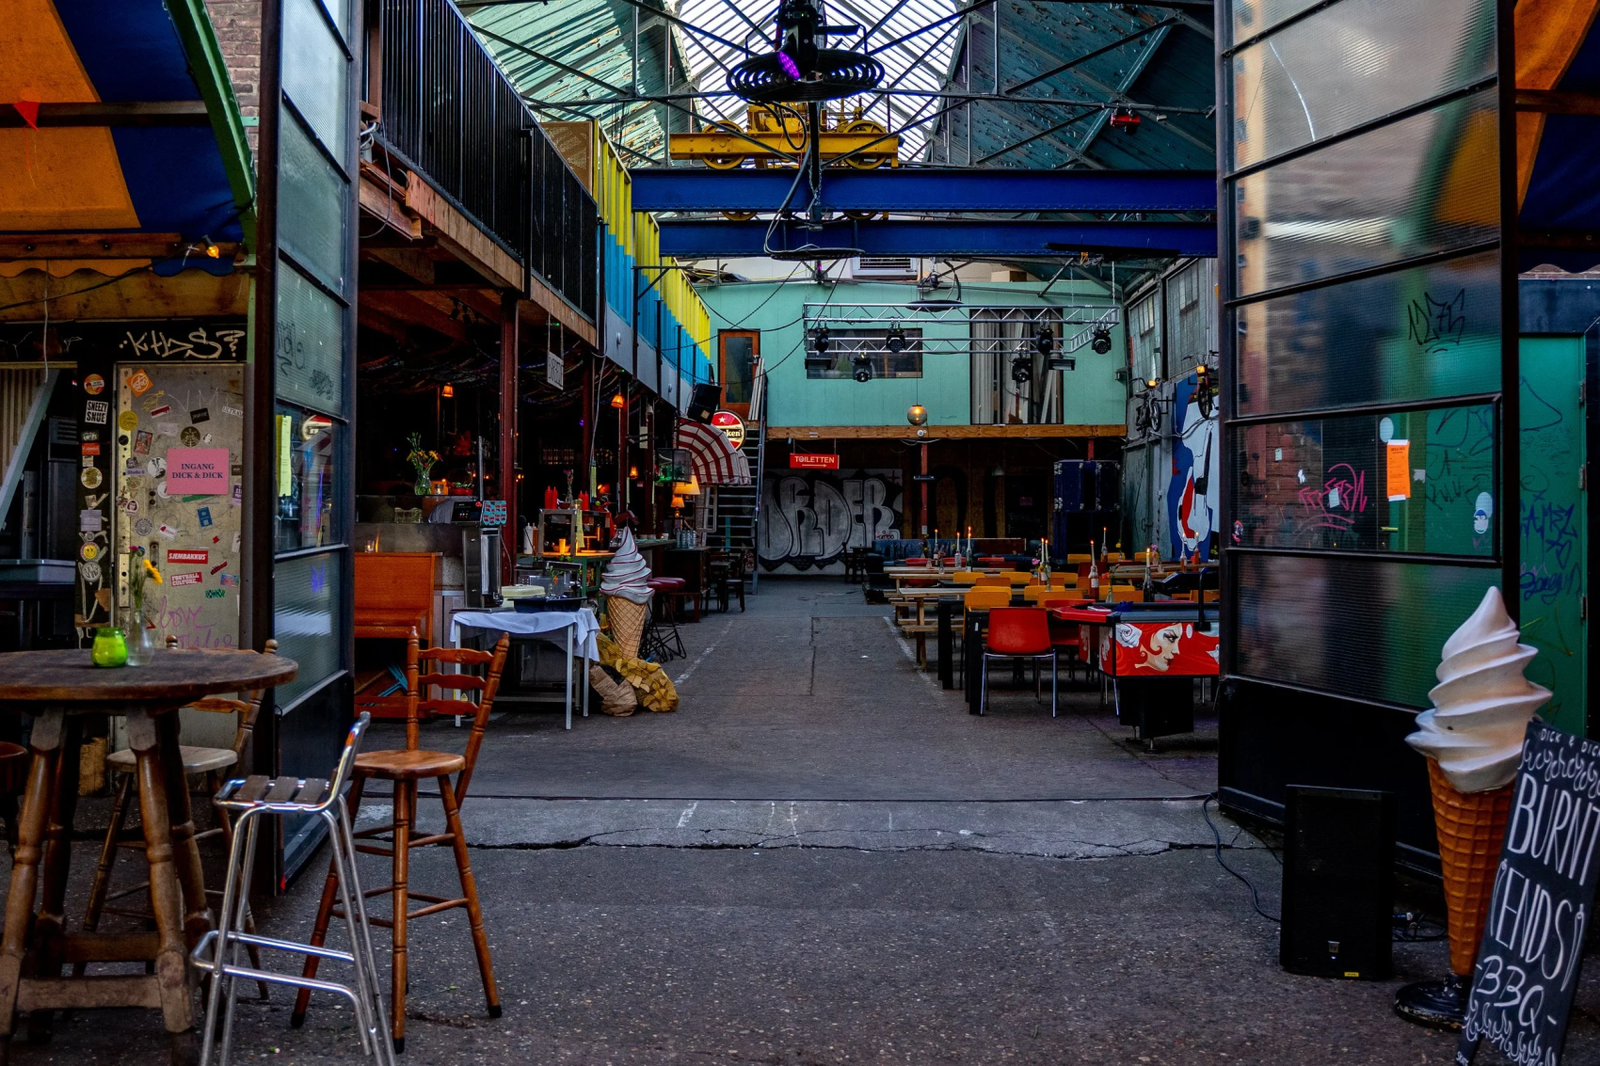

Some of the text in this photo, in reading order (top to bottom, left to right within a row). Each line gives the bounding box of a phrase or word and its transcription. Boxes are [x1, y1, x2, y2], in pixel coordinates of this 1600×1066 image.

[794, 456, 835, 464] TOILETTEN
[1540, 728, 1562, 744] DICK
[1507, 773, 1600, 886] BURNT
[1495, 868, 1573, 980] ENDS
